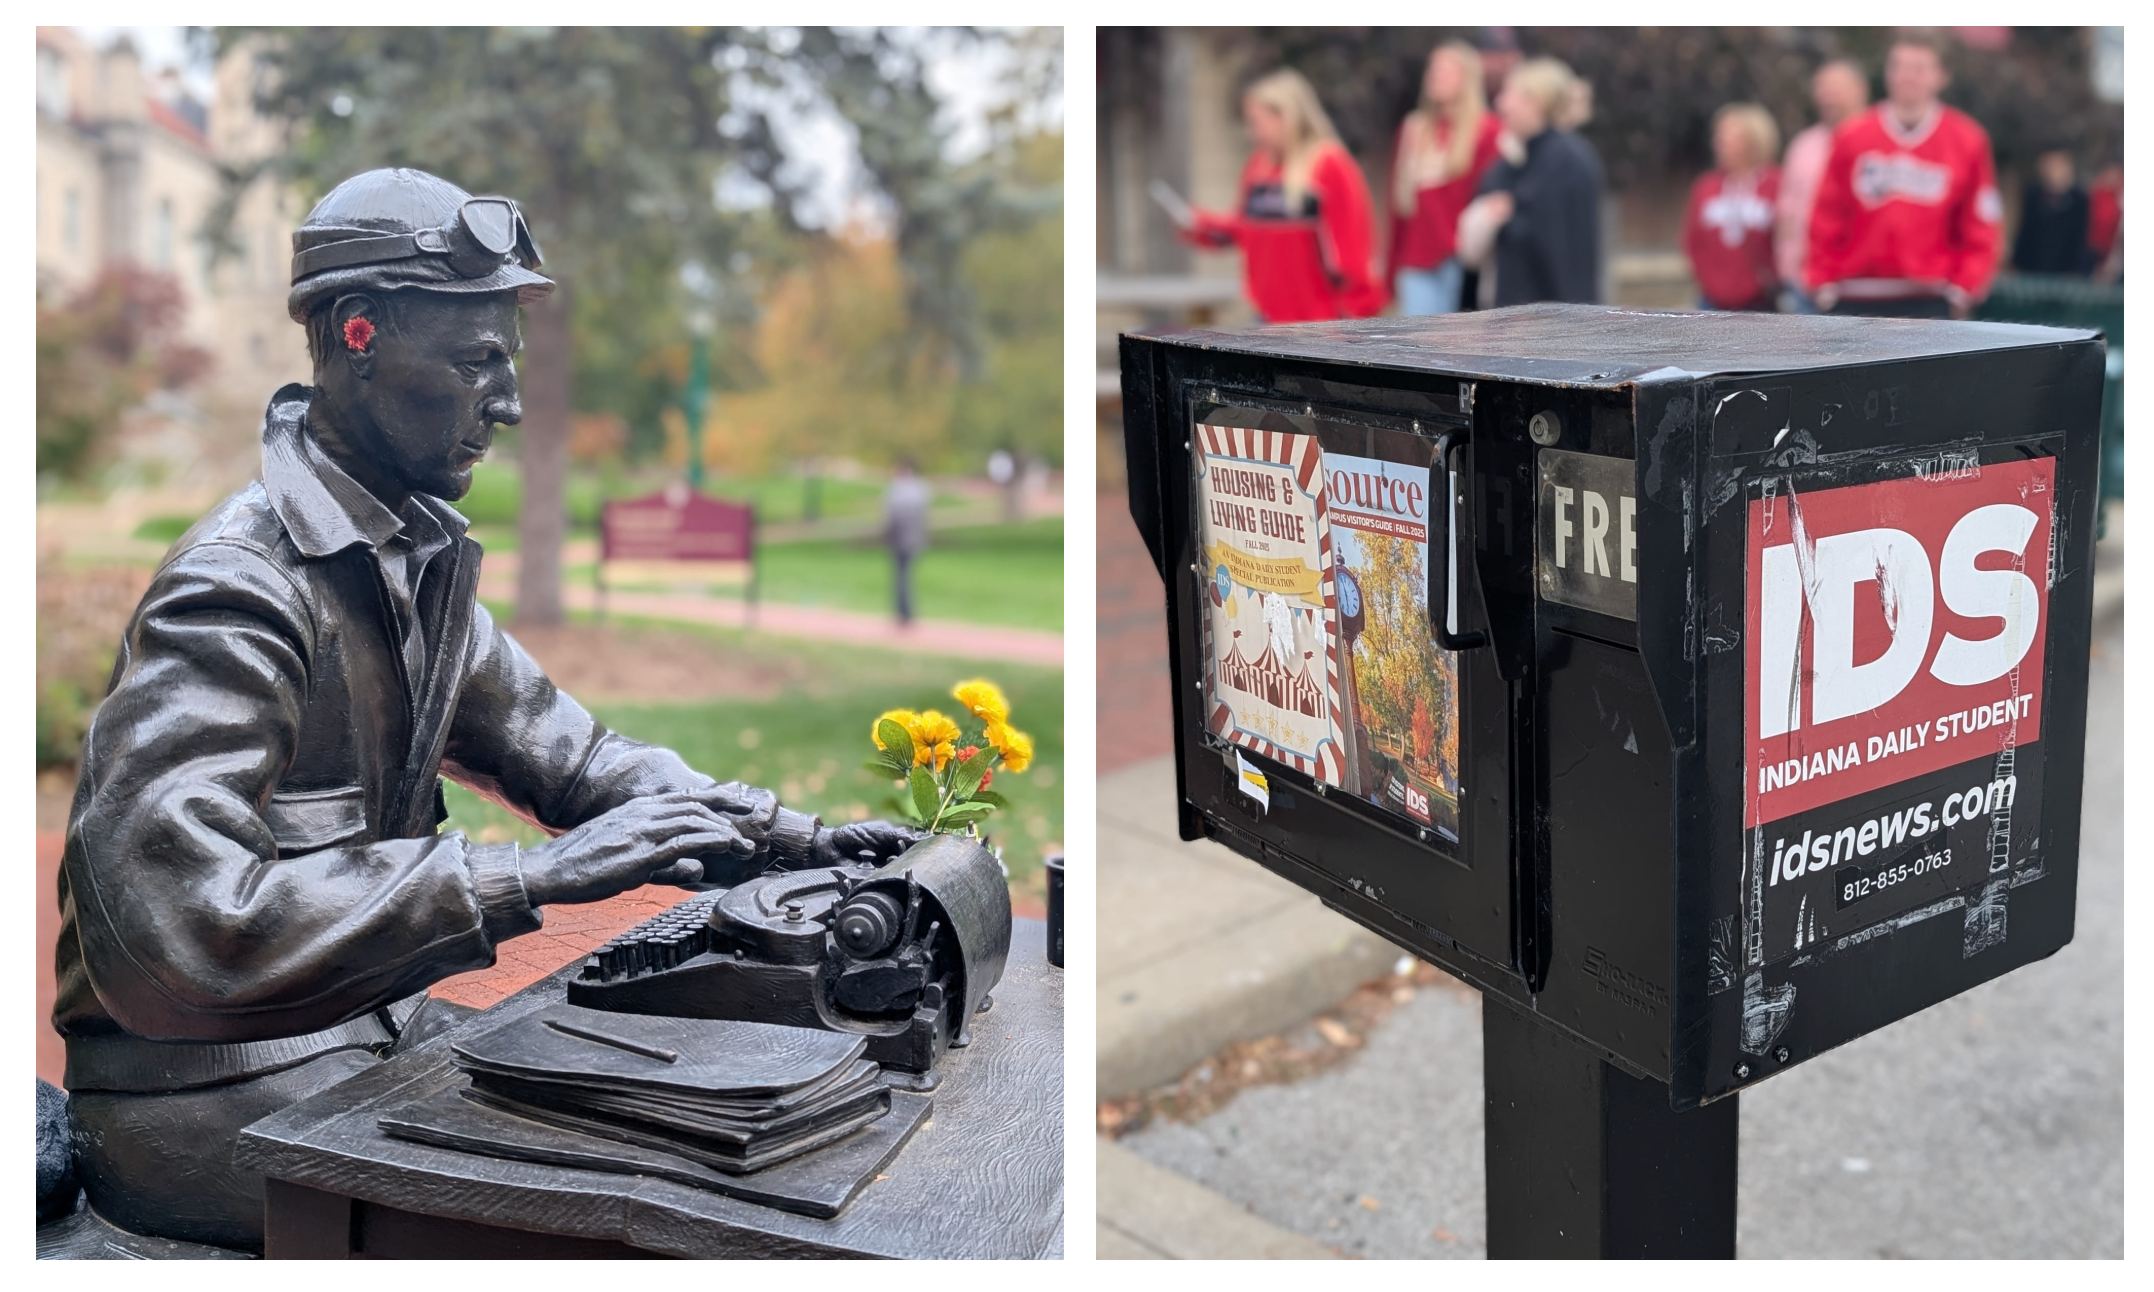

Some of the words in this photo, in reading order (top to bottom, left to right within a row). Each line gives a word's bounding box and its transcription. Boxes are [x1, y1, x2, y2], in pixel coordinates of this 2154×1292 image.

[1210, 466, 1276, 502] HOUSING
[1281, 477, 1294, 506] &
[1209, 499, 1257, 534] LIVING
[1260, 508, 1306, 544] GUIDE
[1329, 511, 1346, 524] MPUS
[1346, 514, 1375, 528] VISITOR'S
[1375, 519, 1393, 532] GUIDE
[1395, 524, 1411, 536] FALL
[1410, 526, 1425, 539] 2025
[1554, 485, 1637, 583] FRE
[1221, 549, 1231, 561] AN
[1230, 553, 1255, 571] INDIANA
[1255, 563, 1275, 574] DAILY
[1274, 564, 1302, 575] STUDENT
[1245, 539, 1258, 550] FALL
[1217, 573, 1231, 588] IDS
[1229, 565, 1255, 582] SPECIAL
[1255, 574, 1295, 588] PUBLICATION
[1759, 503, 2040, 740] IDS
[1759, 742, 1861, 794] INDIANA
[1867, 720, 1931, 763] DAILY
[1934, 694, 2033, 742] STUDENT
[1406, 786, 1429, 816] IDS
[1769, 775, 2017, 887] idsnews.com
[1843, 848, 1952, 902] 812-855-0763
